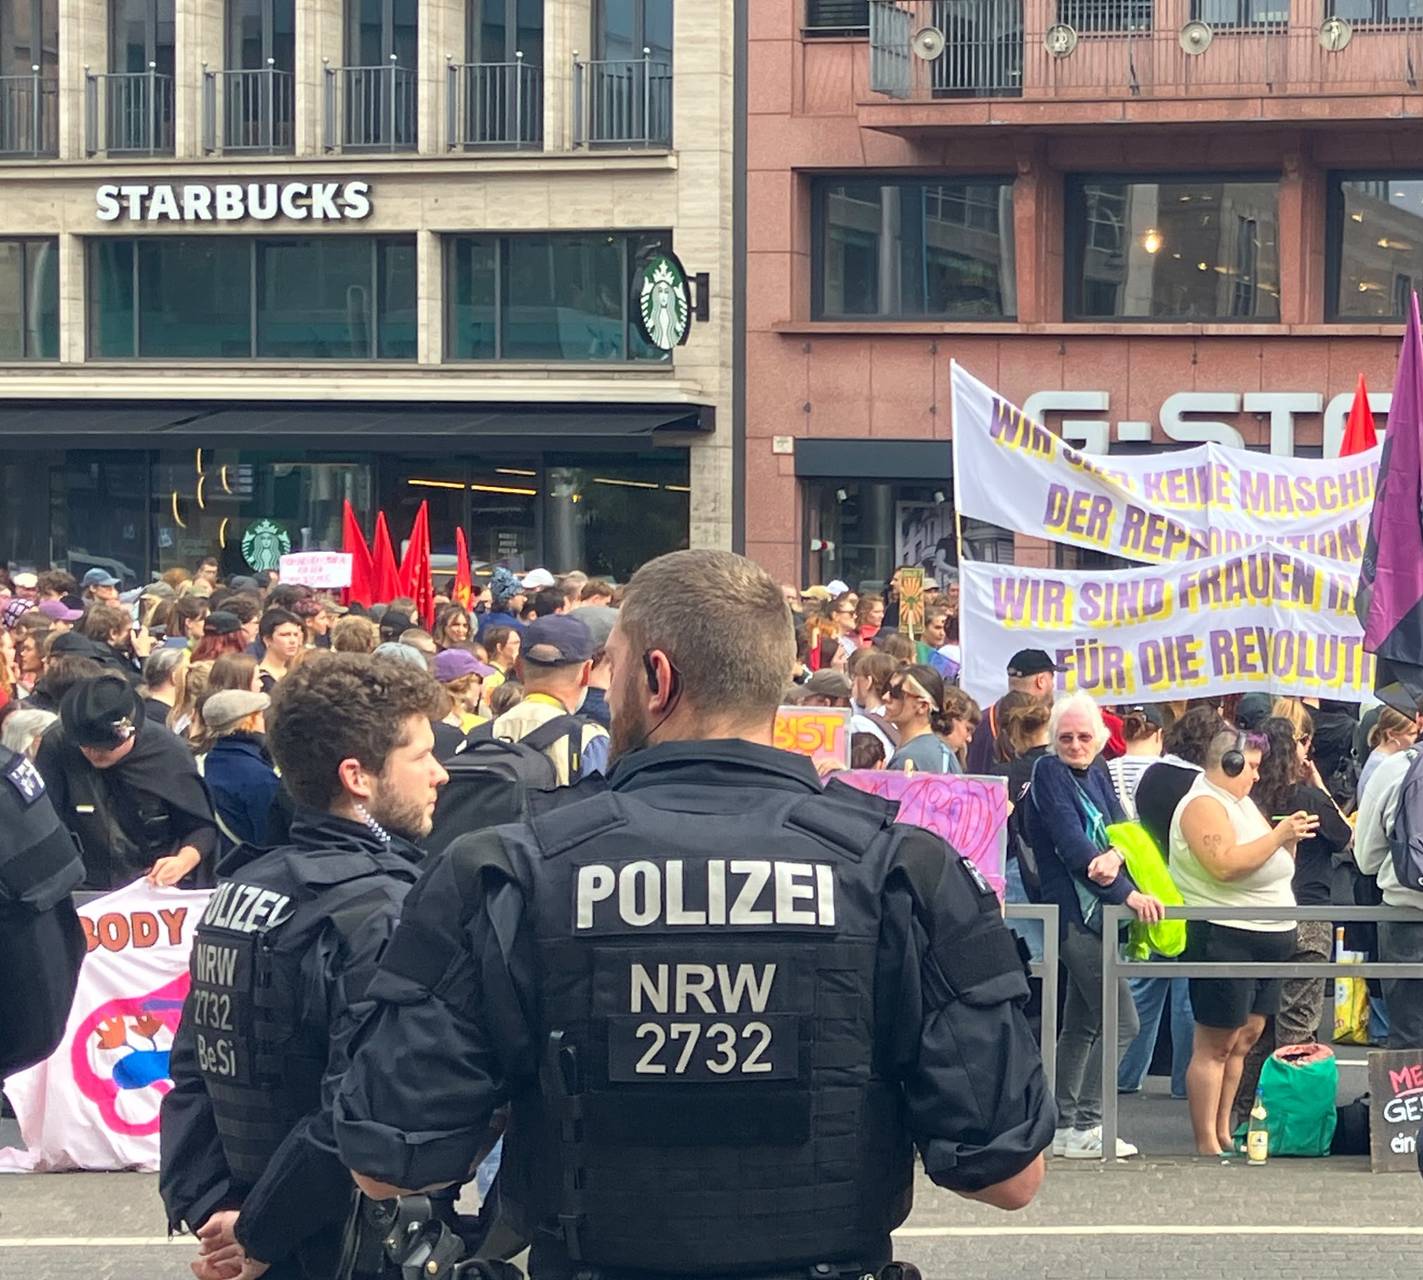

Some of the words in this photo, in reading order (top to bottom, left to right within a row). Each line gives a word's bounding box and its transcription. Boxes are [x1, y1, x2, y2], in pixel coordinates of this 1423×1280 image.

[95, 181, 371, 220] STARBUCKS
[1044, 483, 1114, 545] DER
[1144, 462, 1232, 509] KEINE
[1240, 462, 1378, 517] MASCHI
[992, 576, 1068, 625] WIR
[1079, 577, 1168, 624] SIND
[1178, 552, 1318, 610] FRAUEN
[1055, 638, 1129, 692] FÜR
[1139, 634, 1202, 688] DIE
[577, 860, 835, 929] POLIZEI
[79, 907, 188, 952] BODY
[196, 944, 239, 986] NRW
[631, 964, 777, 1014] NRW
[194, 990, 233, 1031] 2732
[198, 1035, 237, 1076] BeSi
[635, 1022, 773, 1074] 2732
